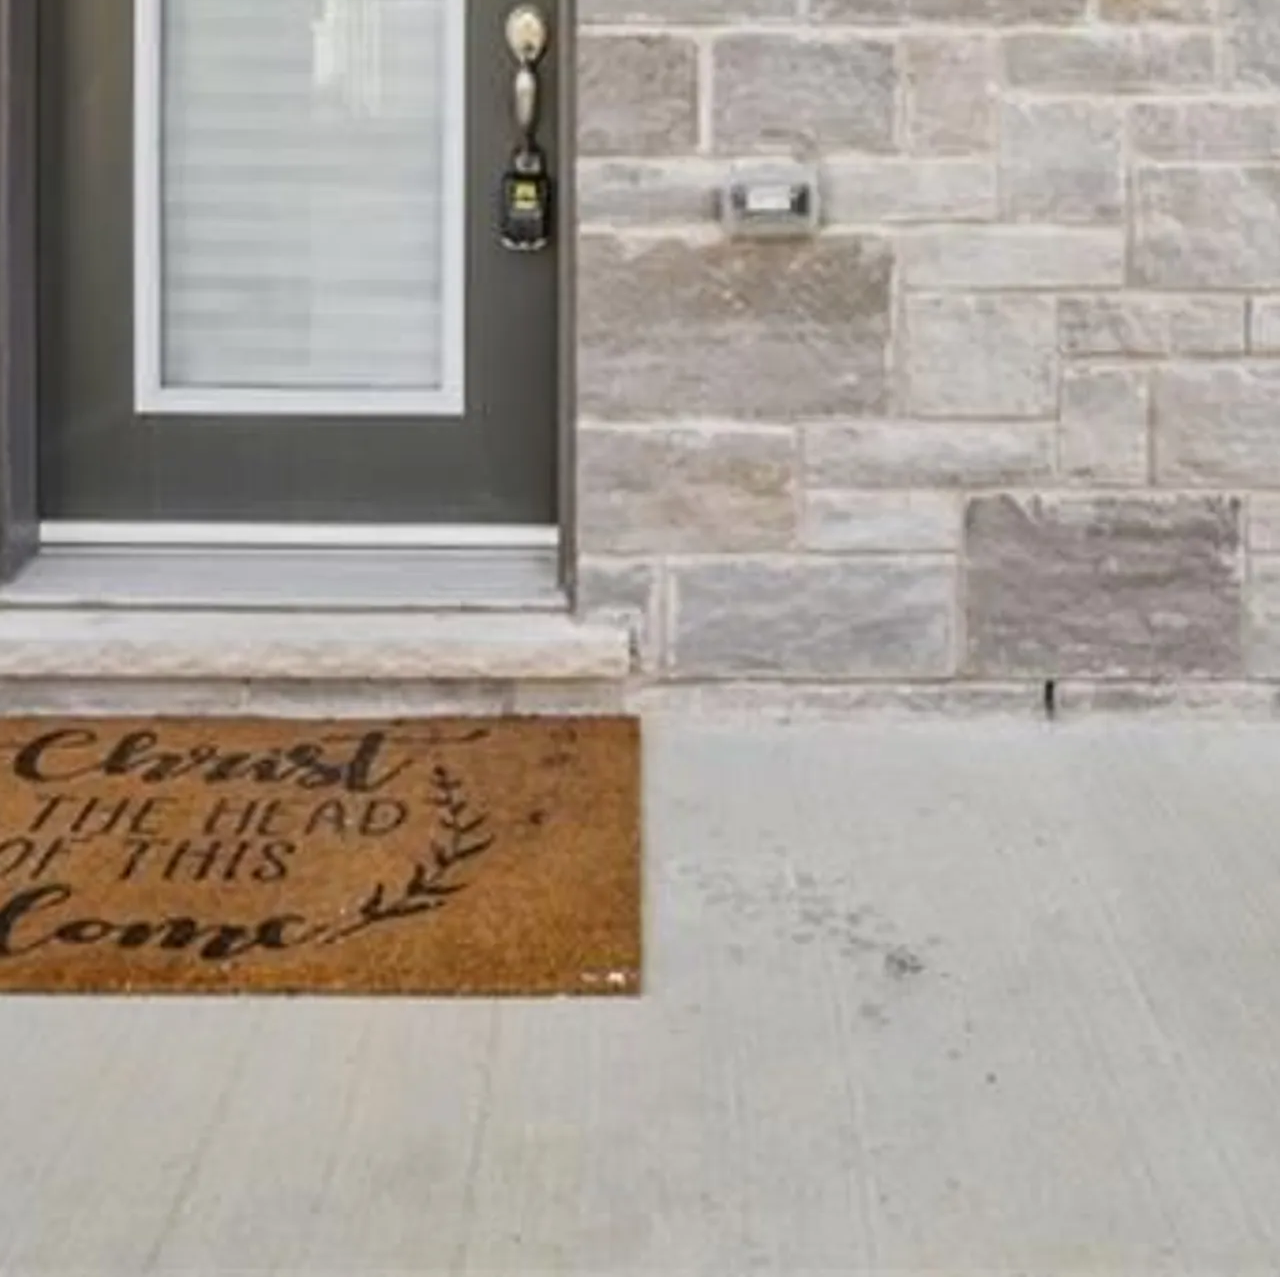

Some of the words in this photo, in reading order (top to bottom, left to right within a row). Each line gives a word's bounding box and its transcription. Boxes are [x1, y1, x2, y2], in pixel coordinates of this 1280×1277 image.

[12, 728, 416, 792] Christ
[28, 795, 178, 834] THE
[202, 797, 408, 837] HEAD
[119, 837, 296, 882] THIS
